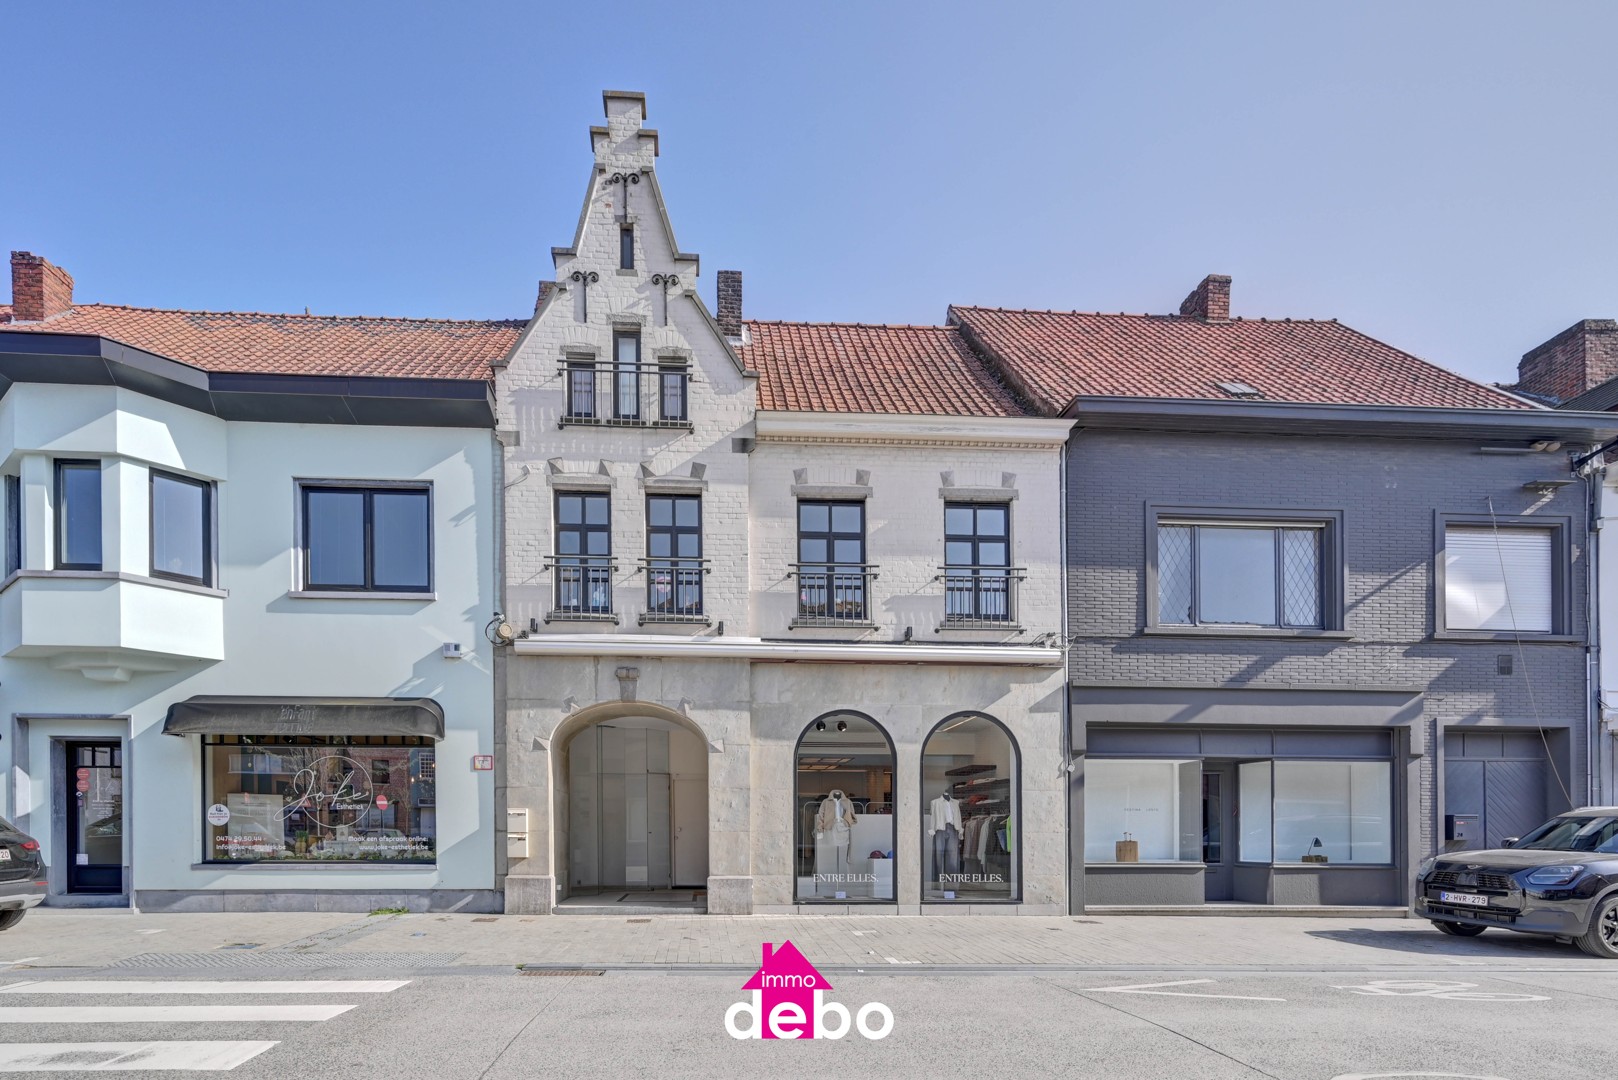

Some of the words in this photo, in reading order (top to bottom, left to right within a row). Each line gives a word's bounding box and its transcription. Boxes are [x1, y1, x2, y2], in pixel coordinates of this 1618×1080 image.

[273, 768, 369, 821] Joke
[336, 802, 363, 810] Esthetiek
[813, 873, 845, 883] ENTRE
[846, 873, 879, 883] ELLES.
[939, 873, 971, 883] ENTRE
[972, 873, 1004, 883] ELLES.
[1445, 893, 1487, 905] 2-HVR-279
